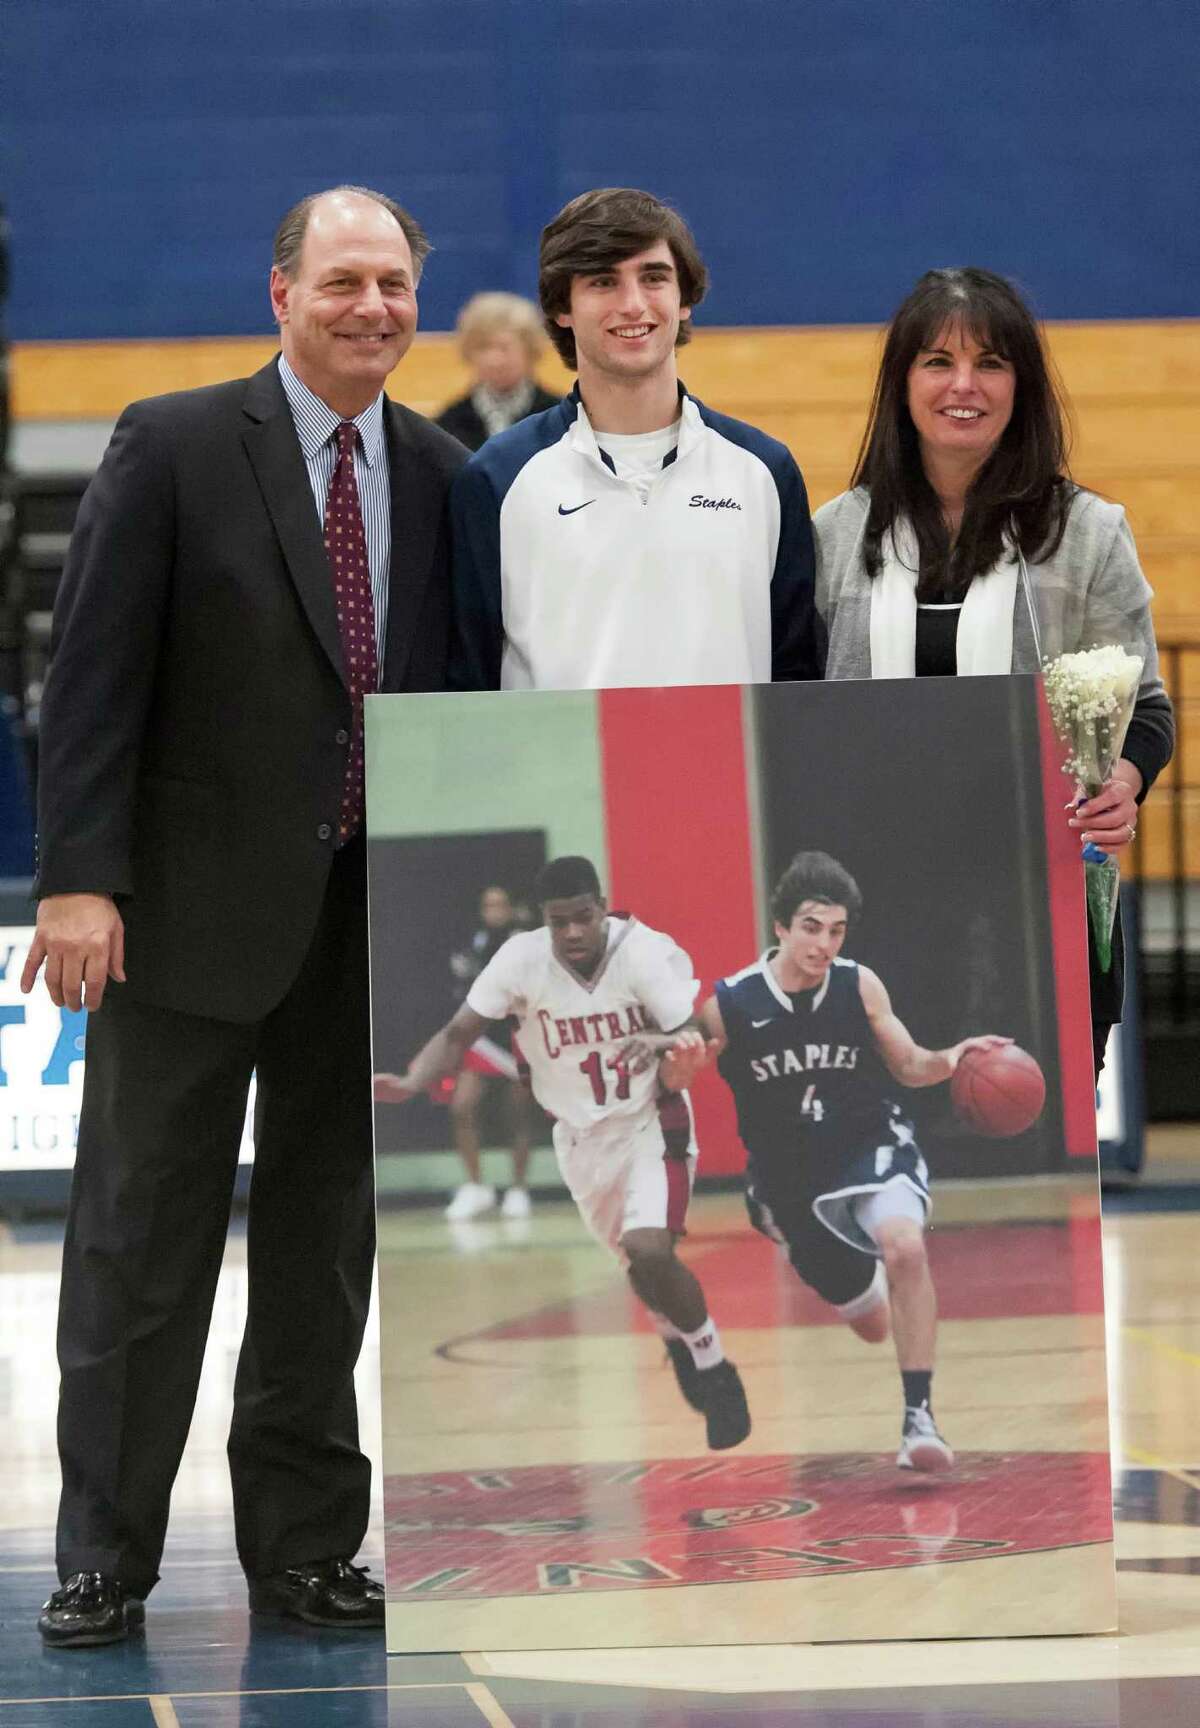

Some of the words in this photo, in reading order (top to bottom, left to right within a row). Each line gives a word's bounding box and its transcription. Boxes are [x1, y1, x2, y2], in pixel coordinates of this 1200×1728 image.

[688, 494, 742, 511] Staples
[750, 1043, 860, 1082] STAPLES
[800, 1084, 825, 1122] 4
